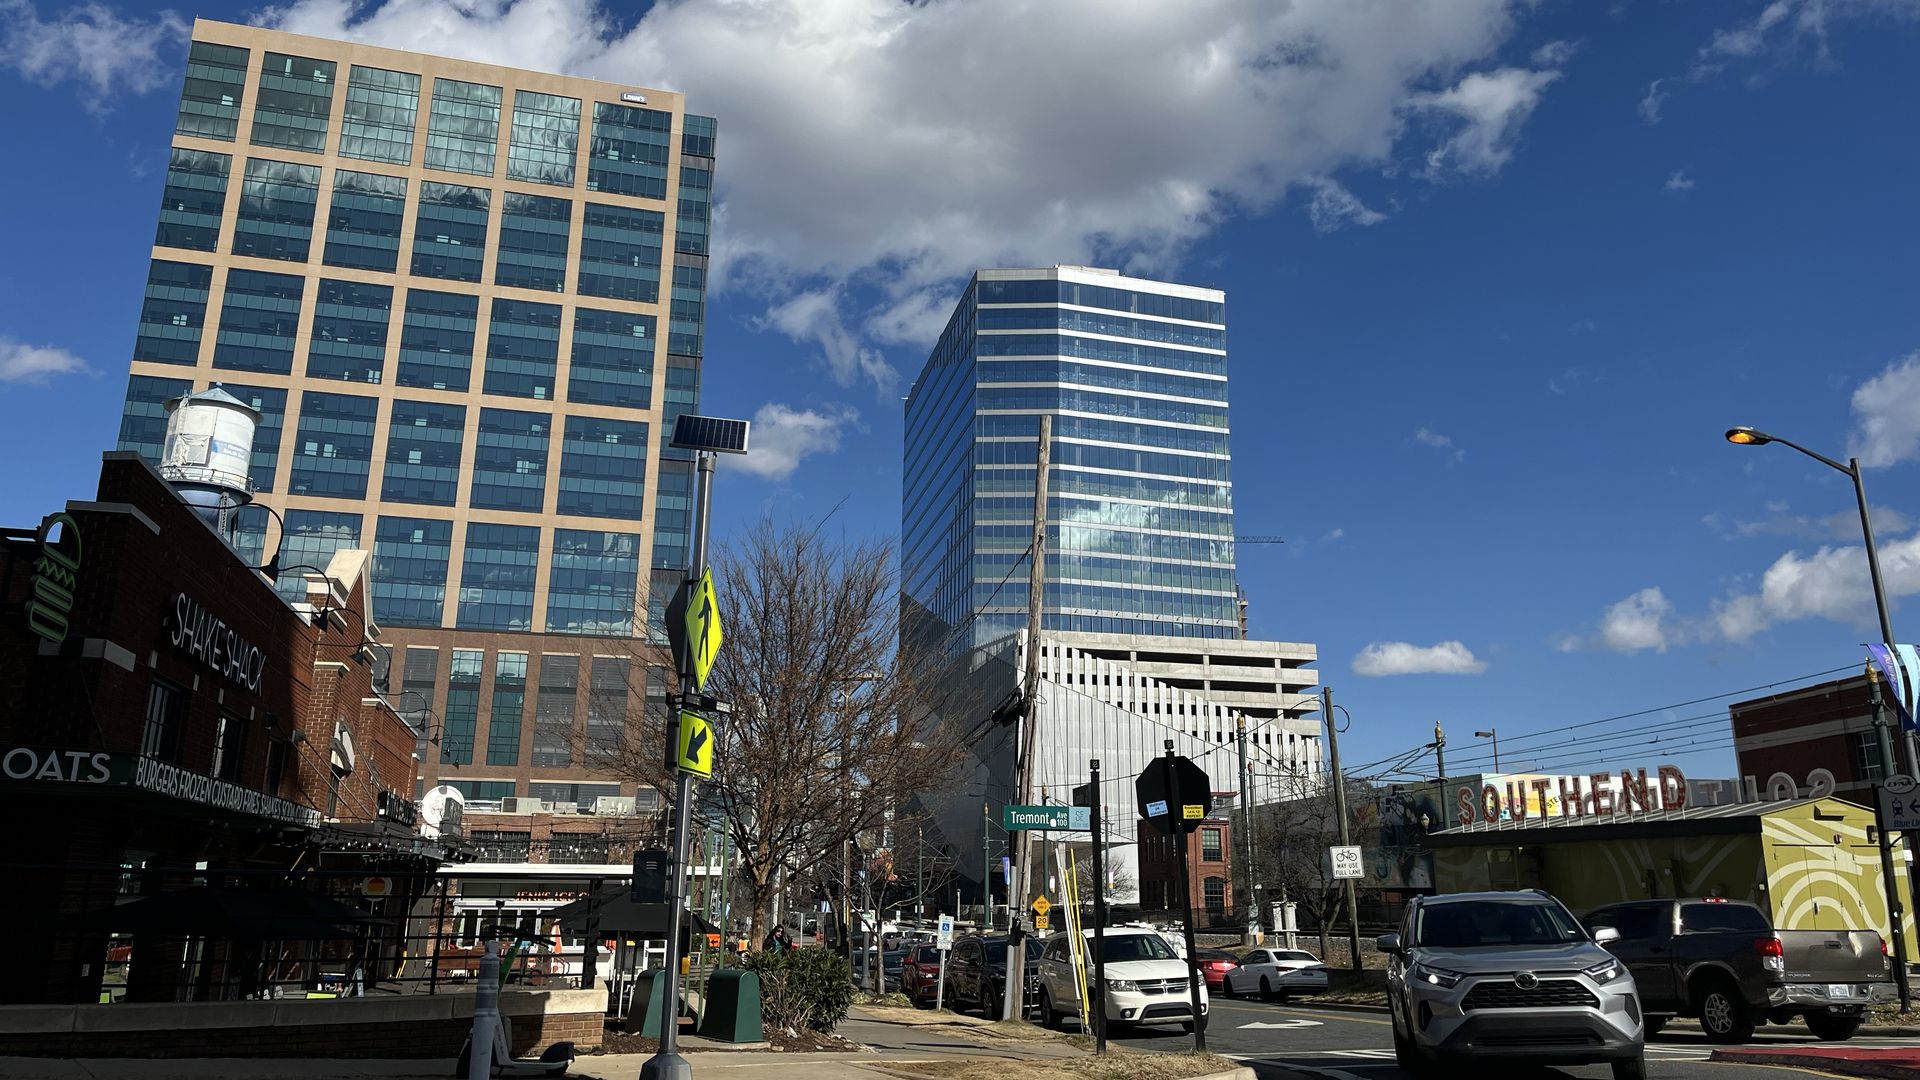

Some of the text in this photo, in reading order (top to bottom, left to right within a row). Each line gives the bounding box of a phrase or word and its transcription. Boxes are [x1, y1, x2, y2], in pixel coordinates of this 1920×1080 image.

[172, 592, 267, 697] SHAKE SHACK
[2, 747, 111, 784] OATS
[136, 756, 180, 796] BURGERS
[178, 770, 213, 803] FROZEN
[211, 780, 244, 810] CUSTARD
[243, 788, 261, 814] FRIES
[1010, 811, 1050, 824] Tremont
[1056, 811, 1068, 819] Ave
[1057, 819, 1068, 827] 100
[1893, 820, 1910, 828] Blue
